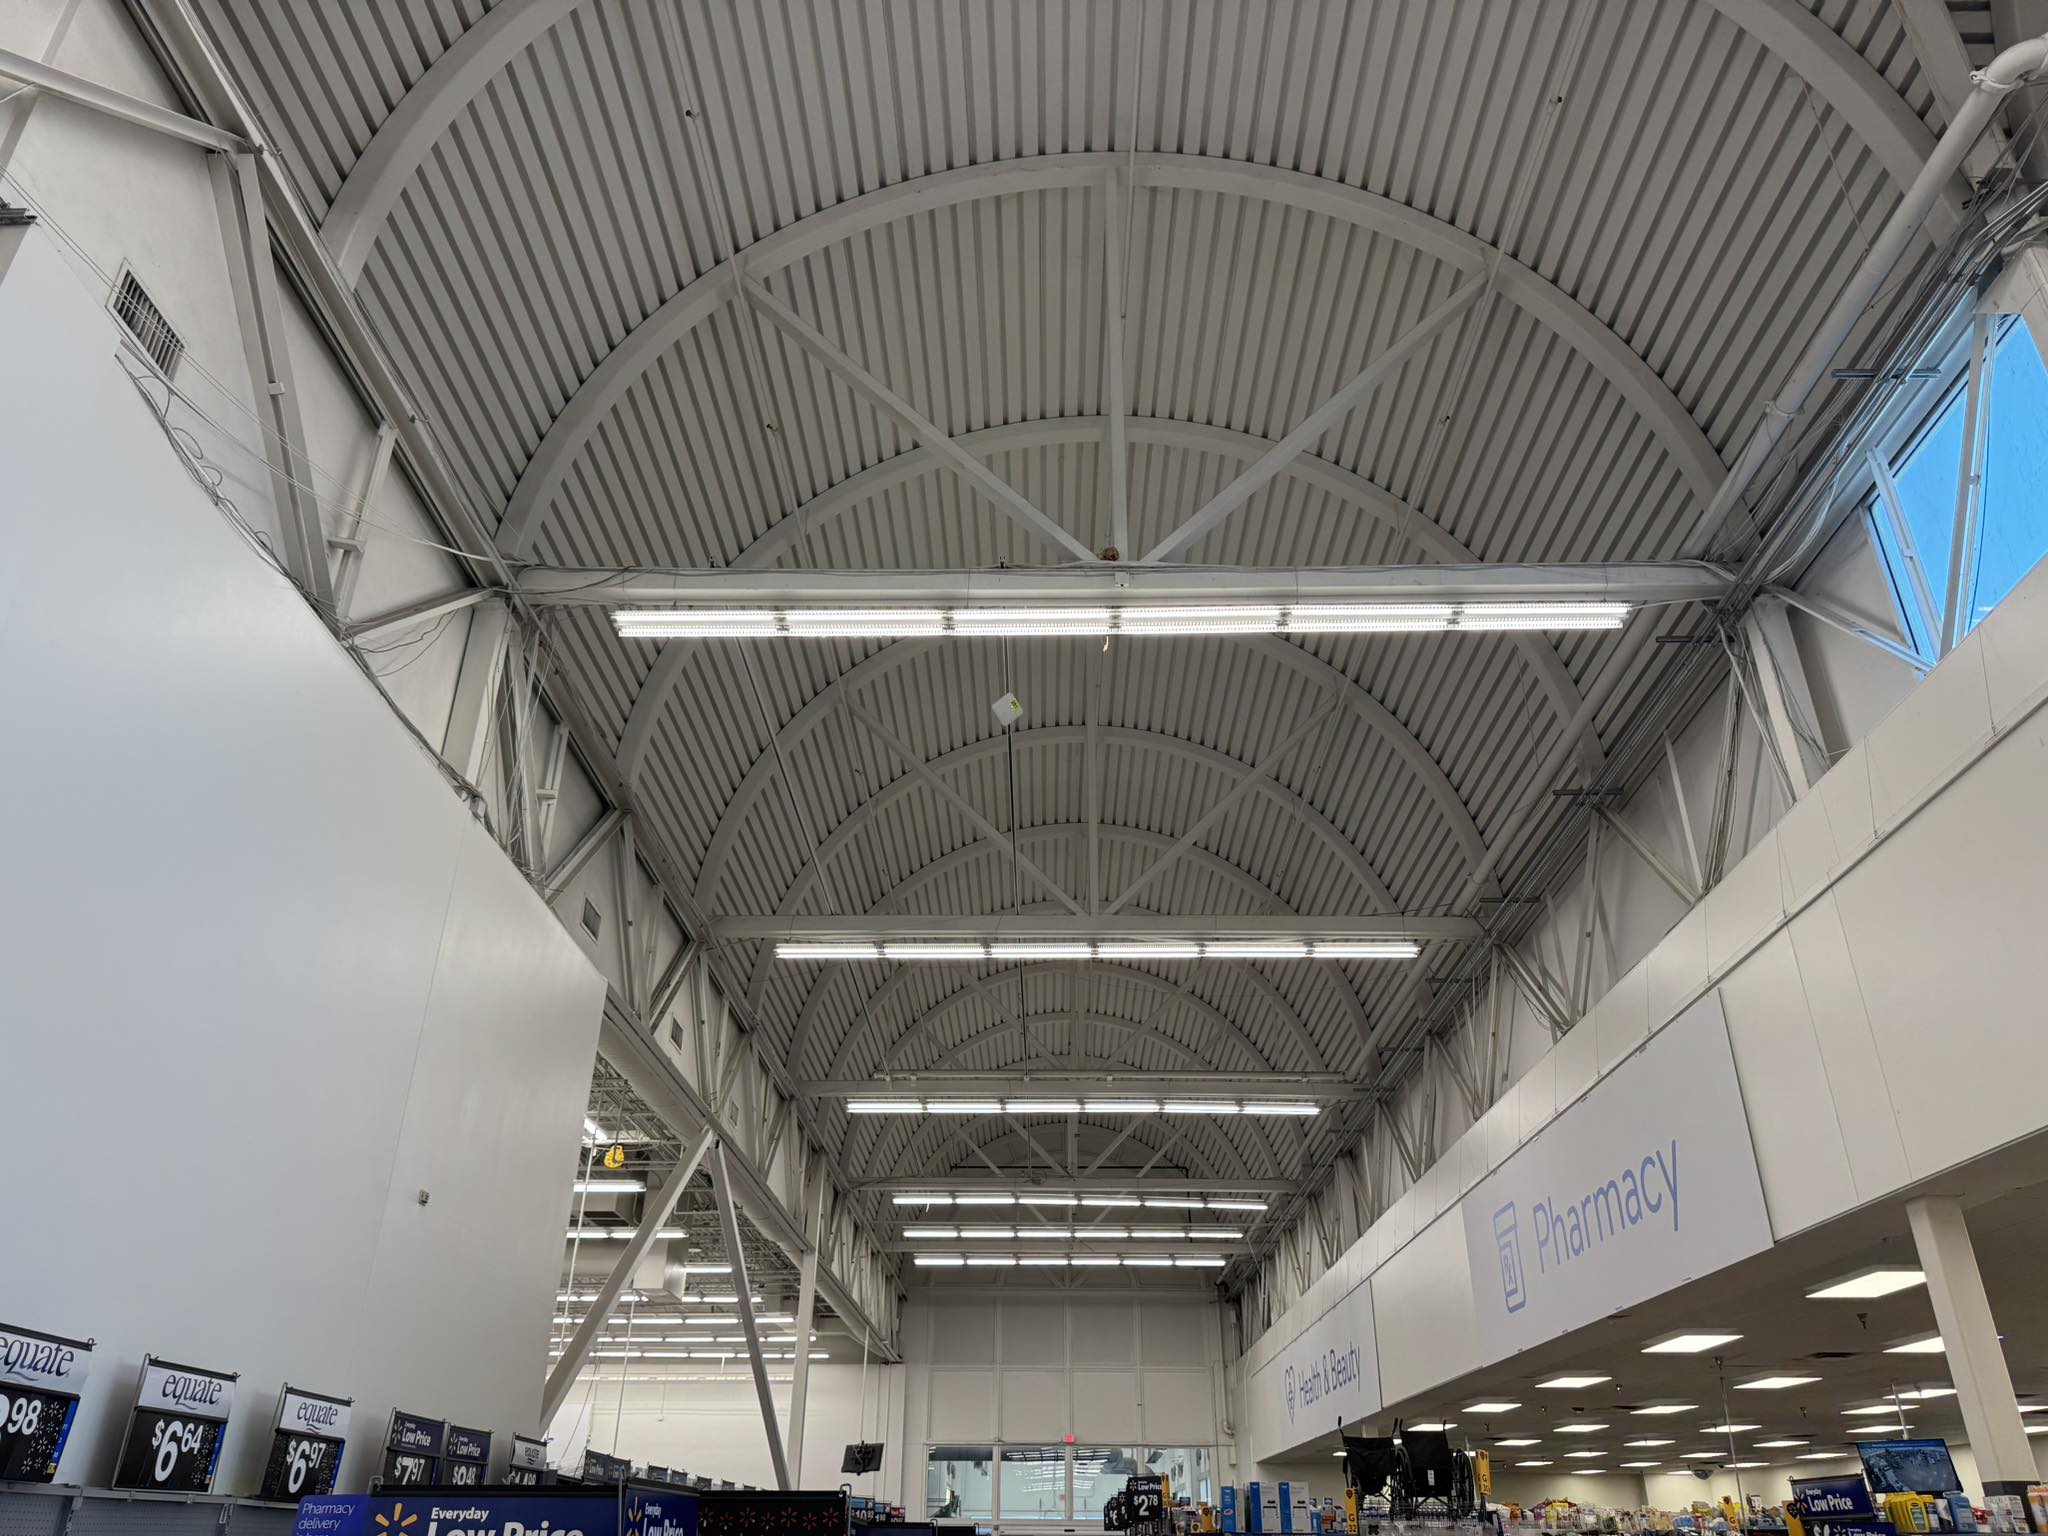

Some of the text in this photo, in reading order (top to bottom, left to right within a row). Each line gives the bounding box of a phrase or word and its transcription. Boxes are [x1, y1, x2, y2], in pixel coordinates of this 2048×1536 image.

[1532, 1139, 1679, 1275] Pharmacy
[1298, 1340, 1360, 1408] Health & Beauty
[162, 1374, 222, 1410] equate
[297, 1402, 338, 1430] equate
[402, 1427, 431, 1447] Low Price
[1149, 1482, 1162, 1490] Pric
[302, 1503, 355, 1515] Pharmacy
[645, 1502, 662, 1519] Everyday
[1807, 1493, 1854, 1512] Low Price
[298, 1518, 341, 1530] delivery
[431, 1507, 489, 1522] Everyday
